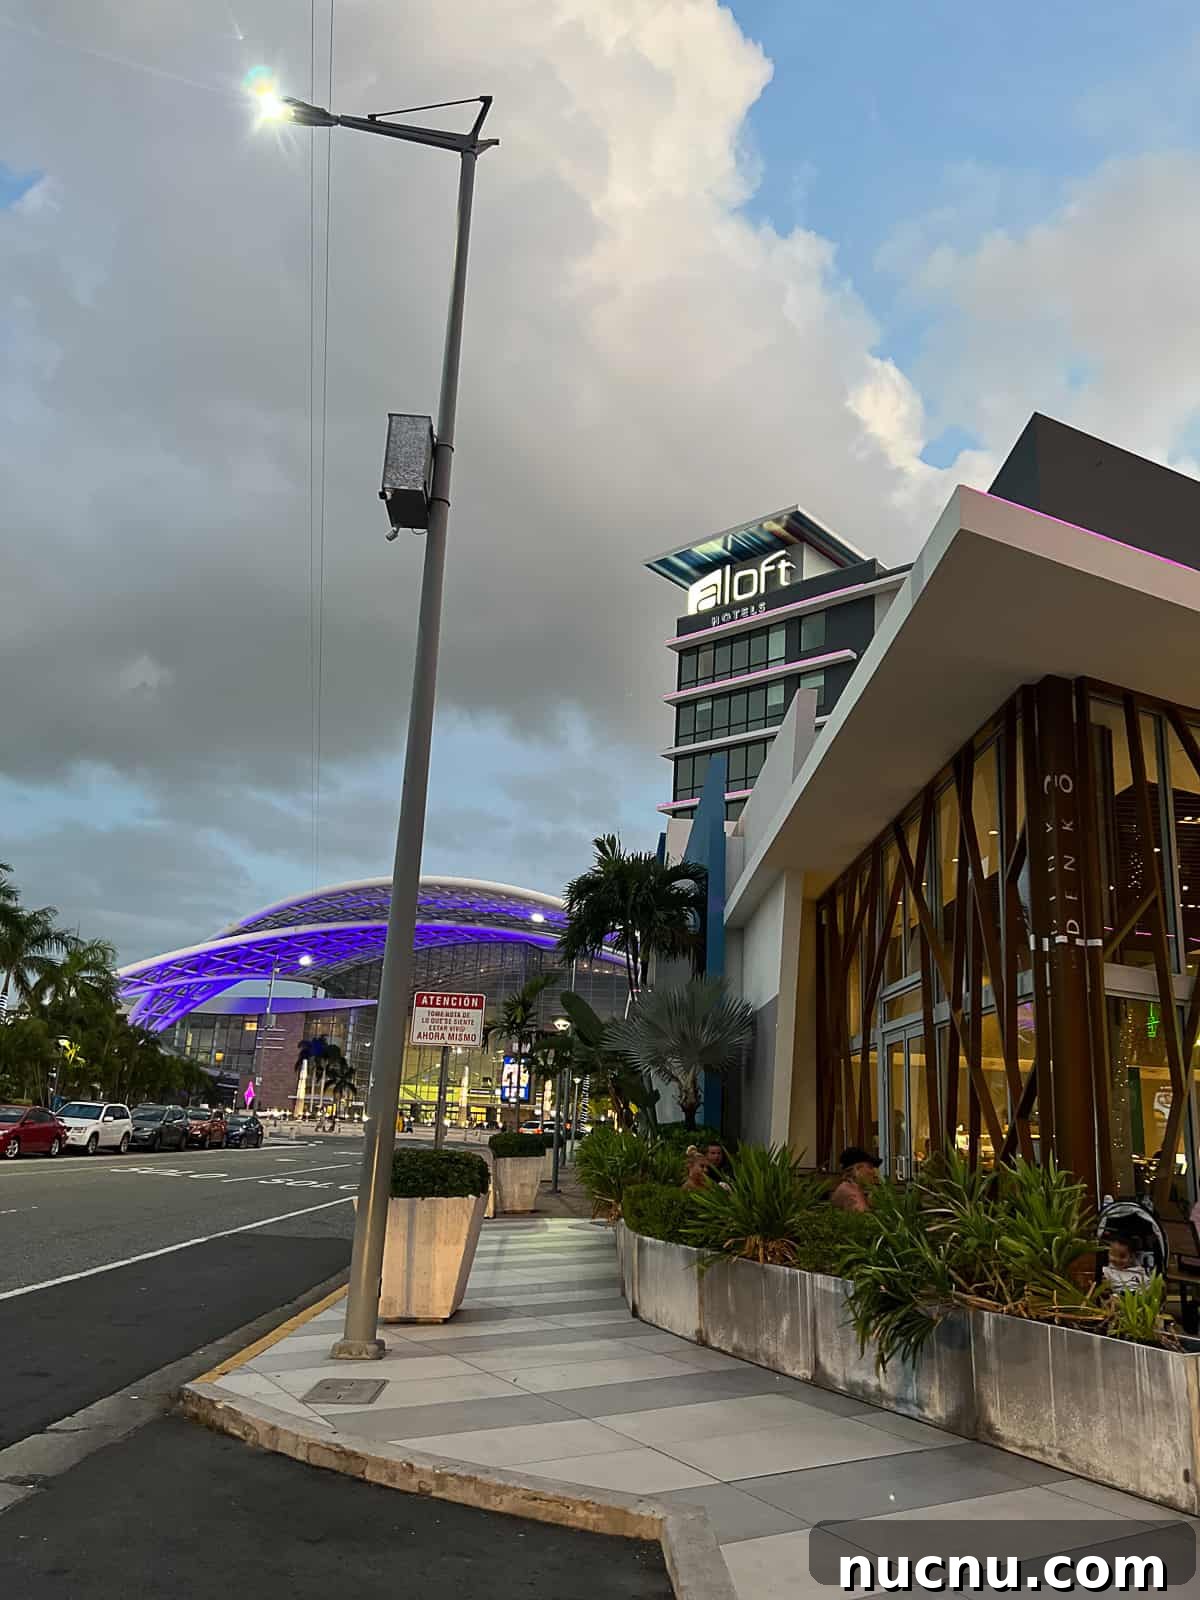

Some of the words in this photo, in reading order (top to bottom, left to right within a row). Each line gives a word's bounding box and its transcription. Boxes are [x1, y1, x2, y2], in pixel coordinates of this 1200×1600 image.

[688, 550, 796, 615] aloft
[711, 602, 766, 627] HOTELS
[416, 1031, 445, 1041] AHORA
[447, 1033, 477, 1042] MISMO
